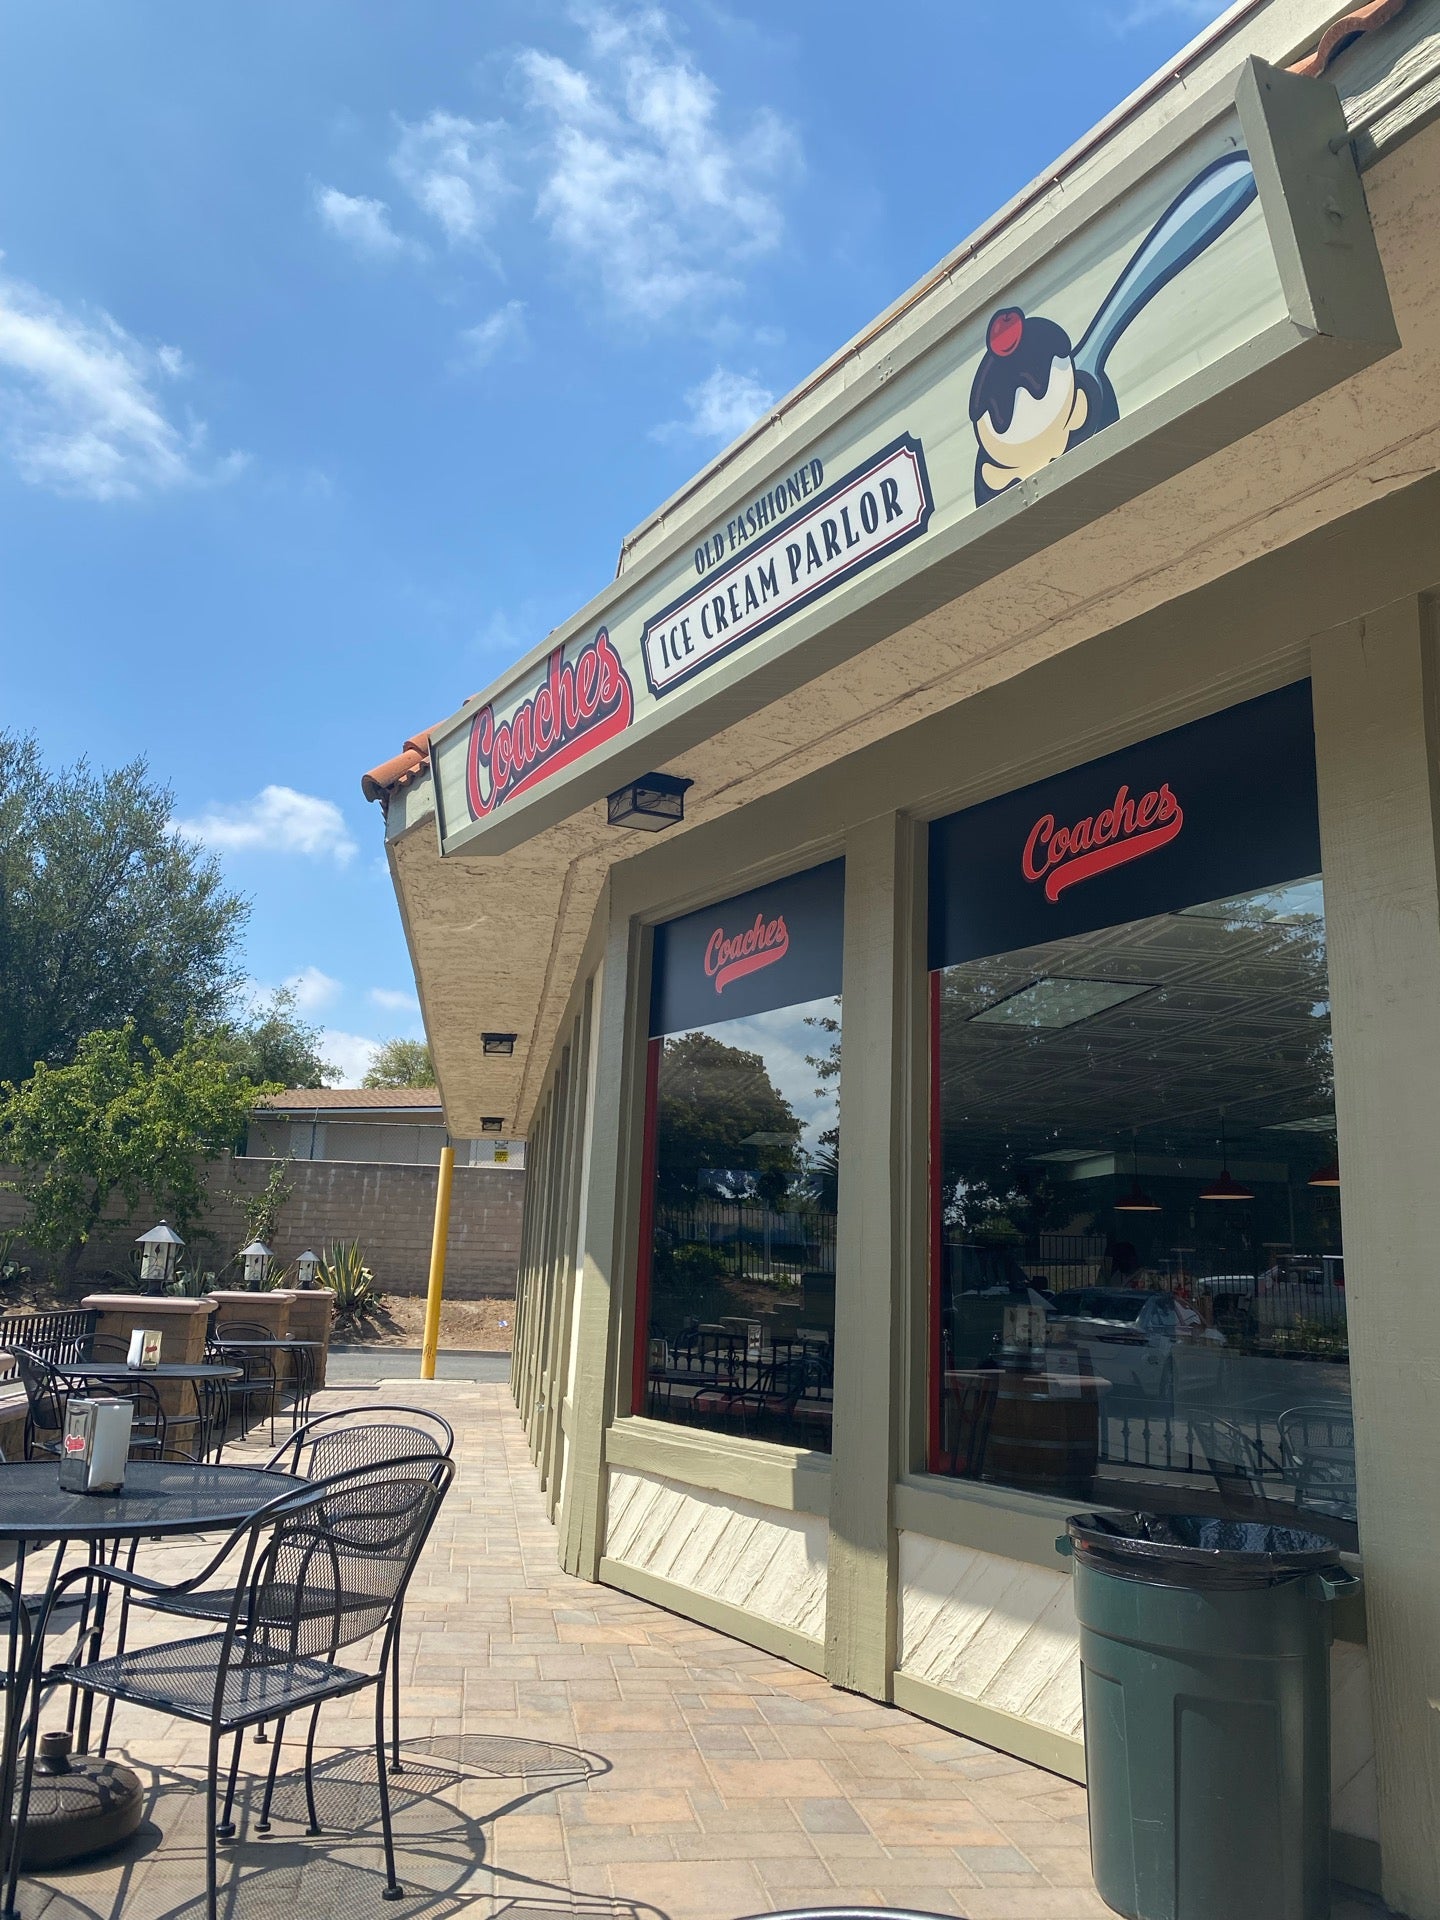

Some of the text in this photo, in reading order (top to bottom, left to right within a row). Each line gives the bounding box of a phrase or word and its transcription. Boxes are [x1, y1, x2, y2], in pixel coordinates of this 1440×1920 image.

[659, 476, 904, 671] ICE CREAM PARLOR
[693, 458, 825, 576] OLD FASHIONED
[466, 626, 634, 822] Coaches
[1021, 783, 1184, 883] Coaches
[704, 912, 790, 980] Coaches
